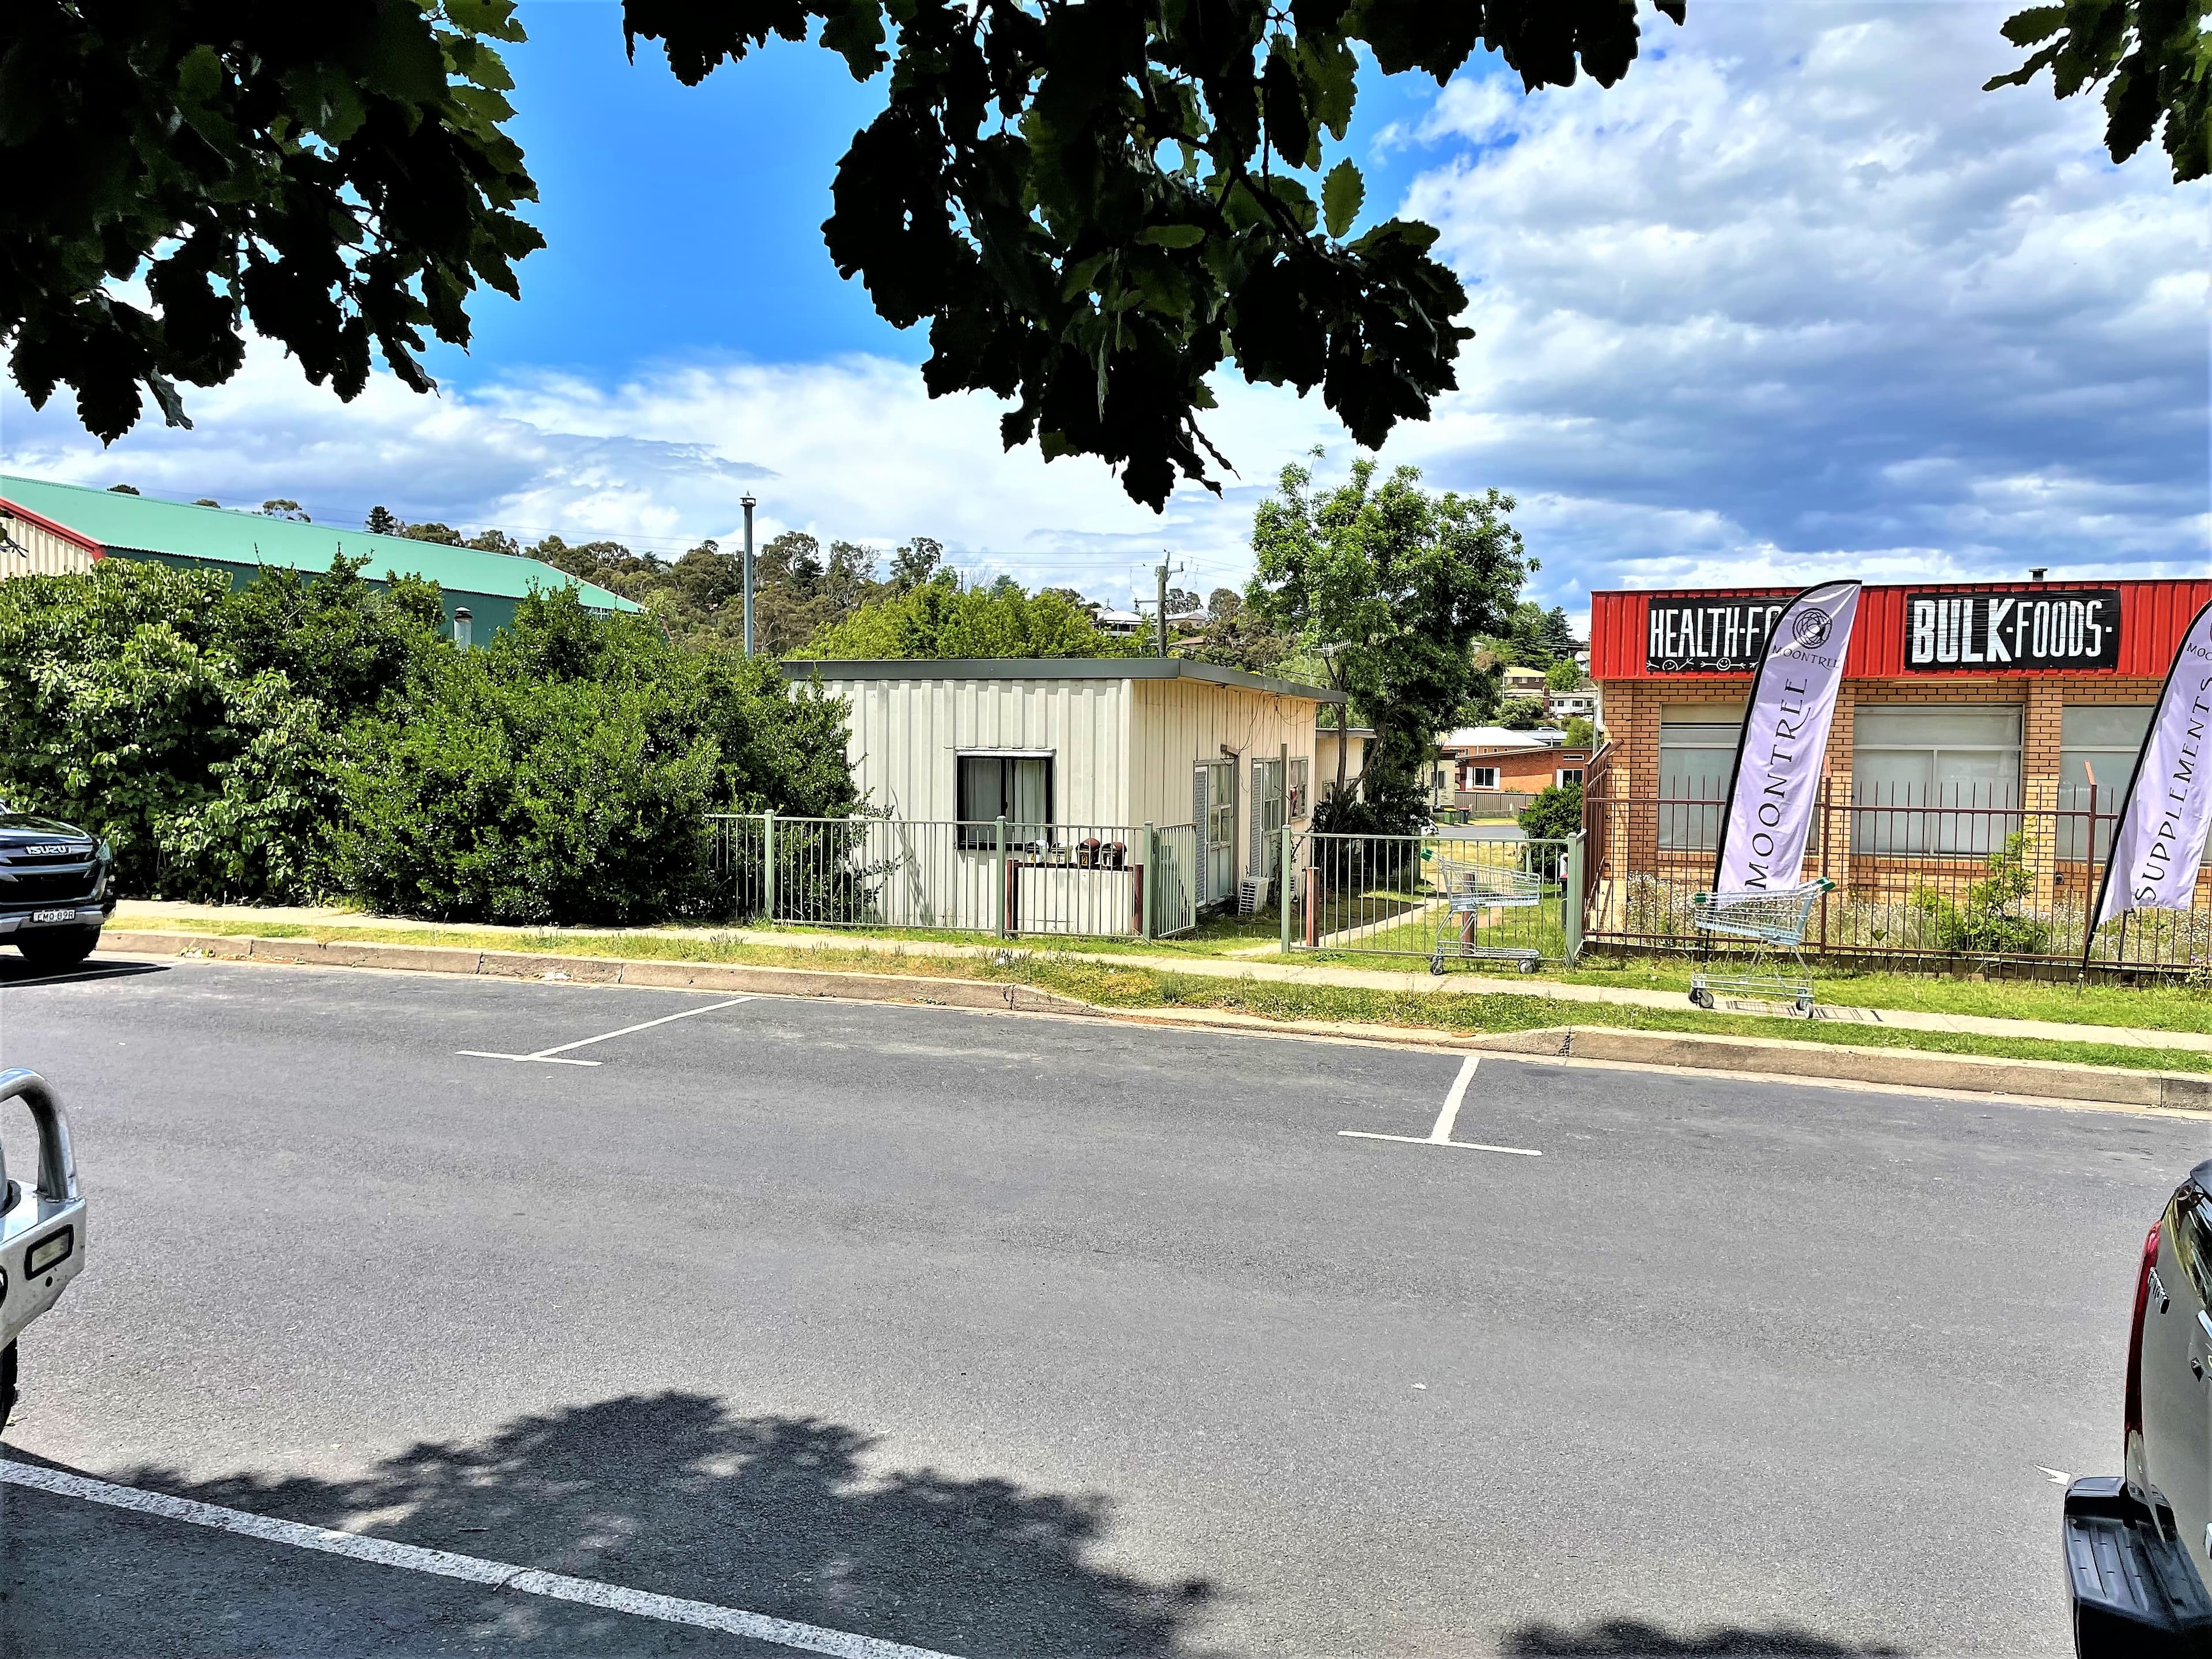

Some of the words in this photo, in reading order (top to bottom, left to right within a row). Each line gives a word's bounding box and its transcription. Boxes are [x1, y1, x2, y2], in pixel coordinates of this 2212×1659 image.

[1772, 645, 1840, 671] MOONTREE
[1745, 678, 1811, 890] MOONTREE
[2135, 677, 2212, 901] SUPPLEMENTS
[26, 845, 71, 855] ISUZU
[1082, 856, 1087, 865] 2
